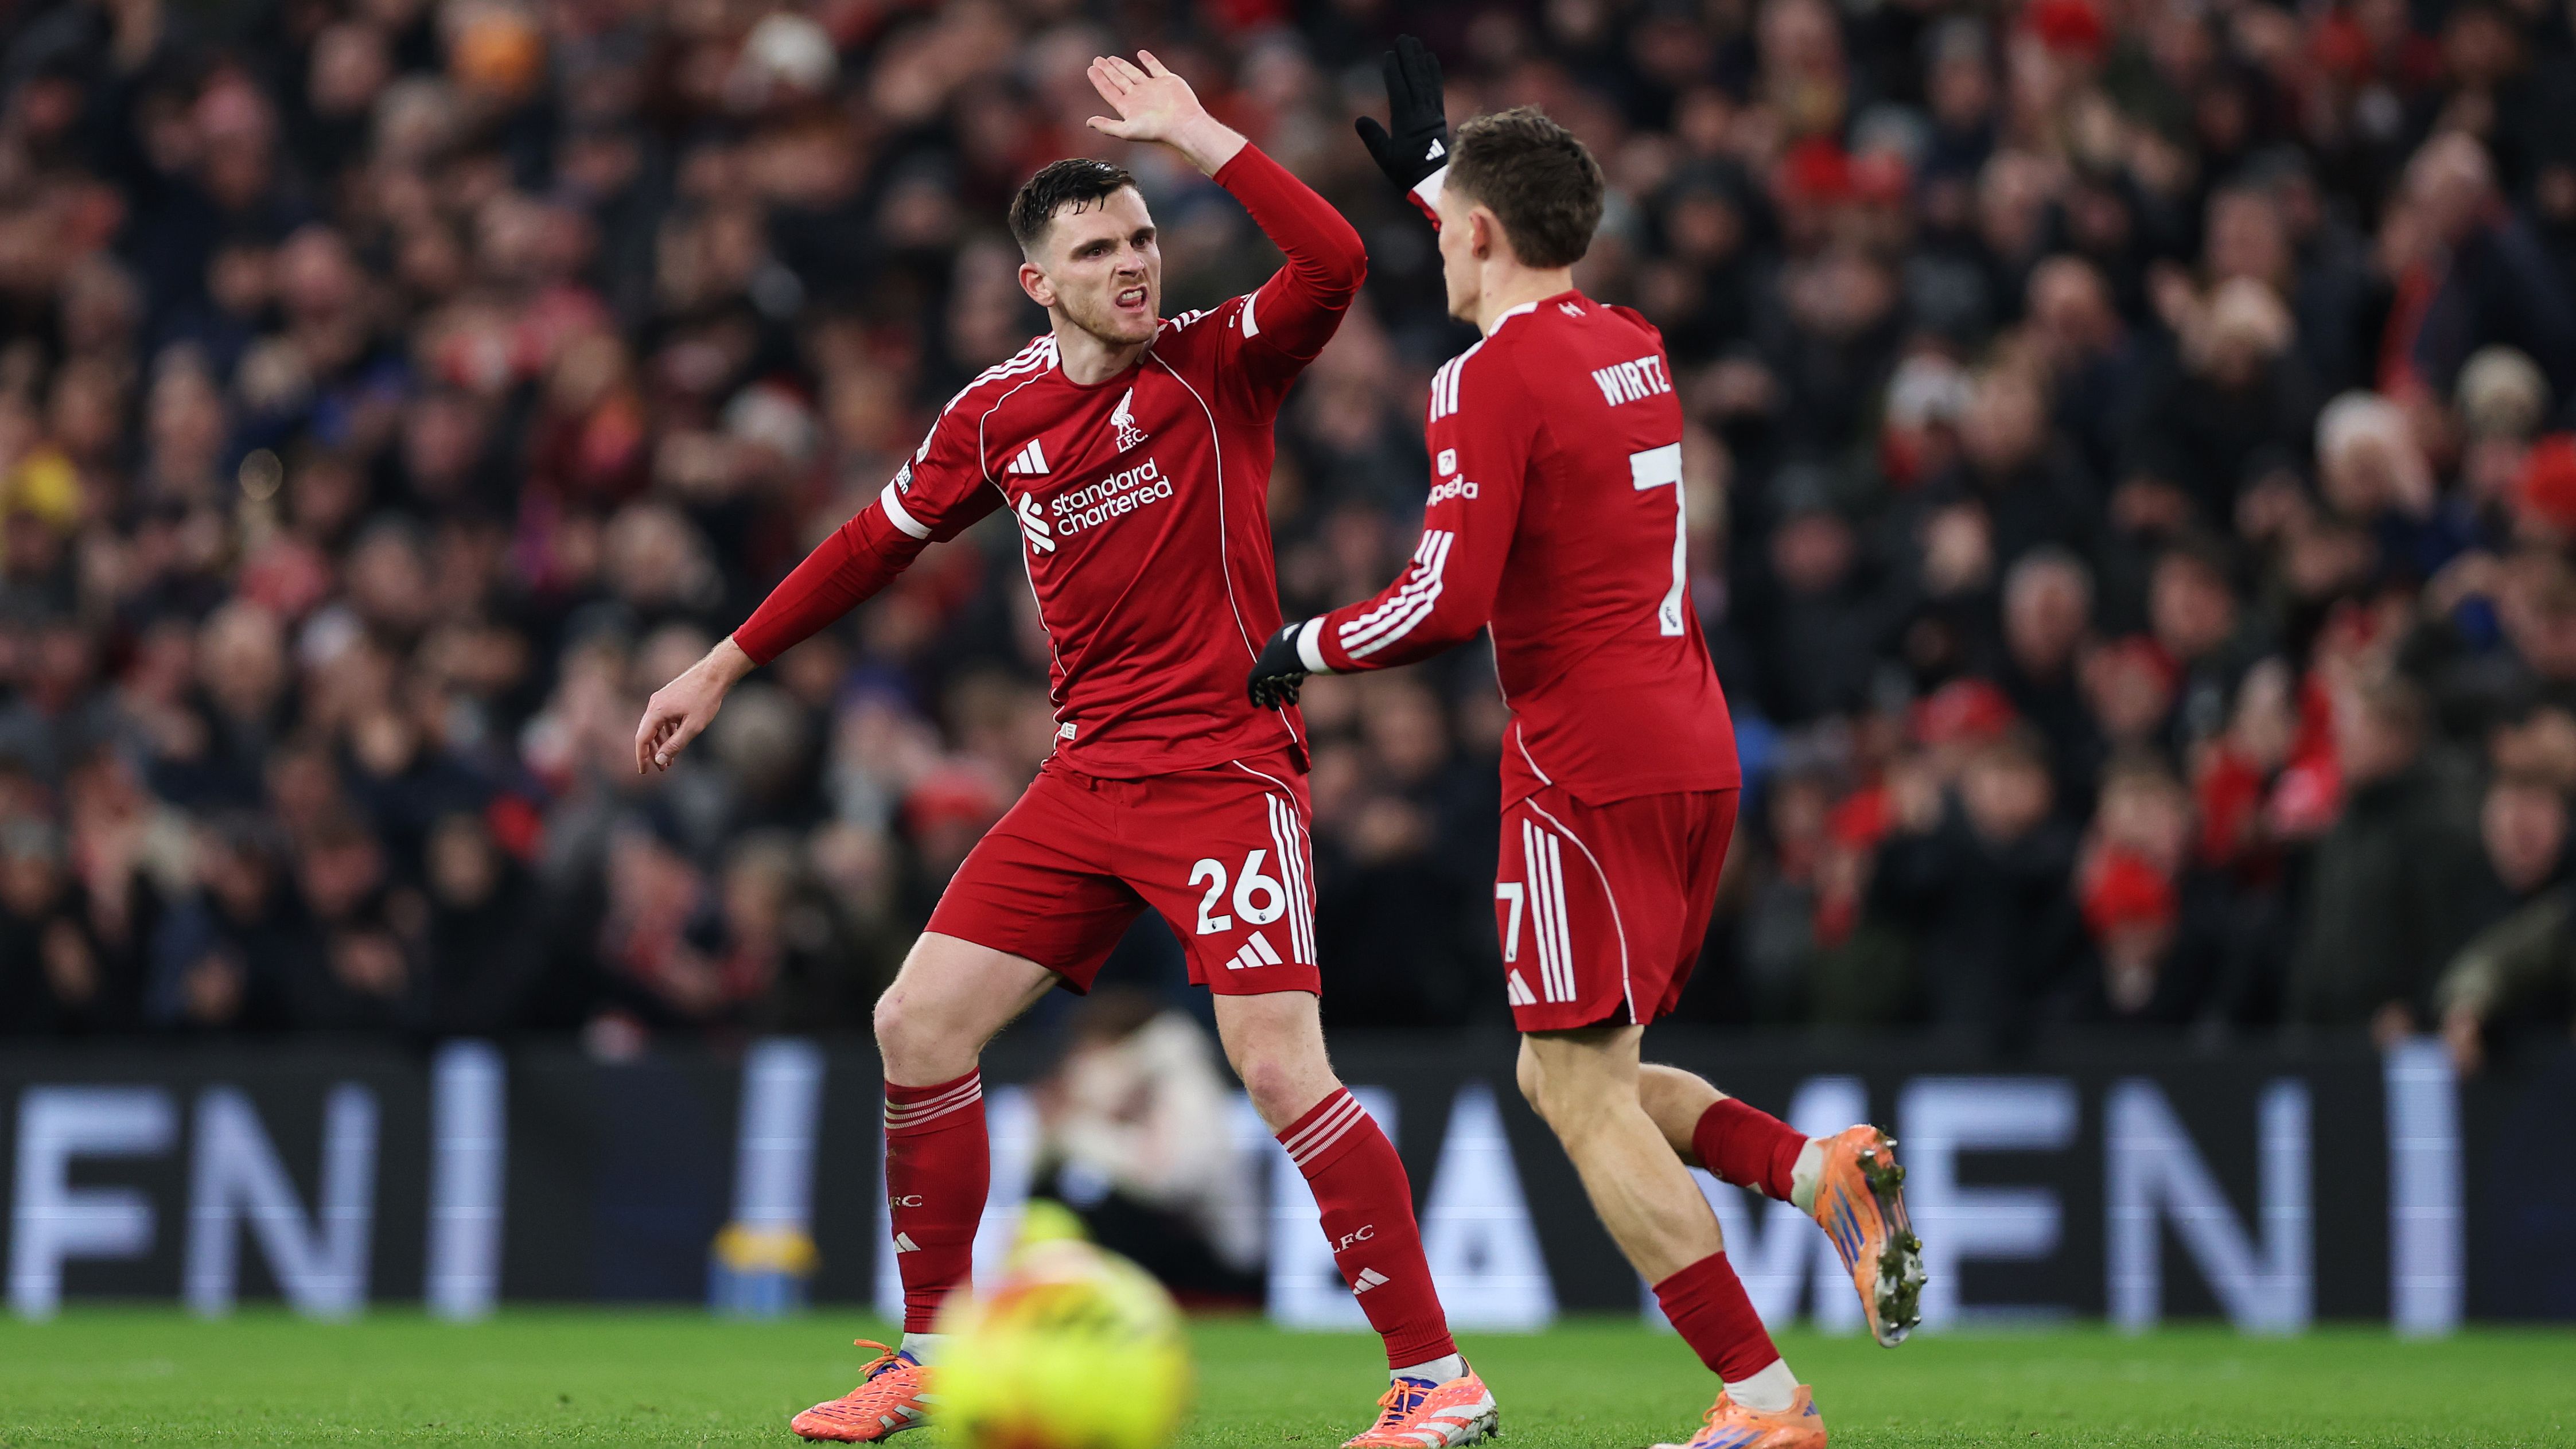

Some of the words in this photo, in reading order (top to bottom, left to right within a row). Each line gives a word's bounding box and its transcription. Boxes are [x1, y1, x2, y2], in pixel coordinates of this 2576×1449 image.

[1591, 355, 1671, 407] WIRTZ
[1051, 457, 1158, 516] standard
[1058, 476, 1173, 536] chartered
[1629, 441, 1687, 636] 7
[1188, 849, 1286, 935] 26
[1495, 882, 1524, 963] 7
[1328, 1224, 1375, 1253] LFC
